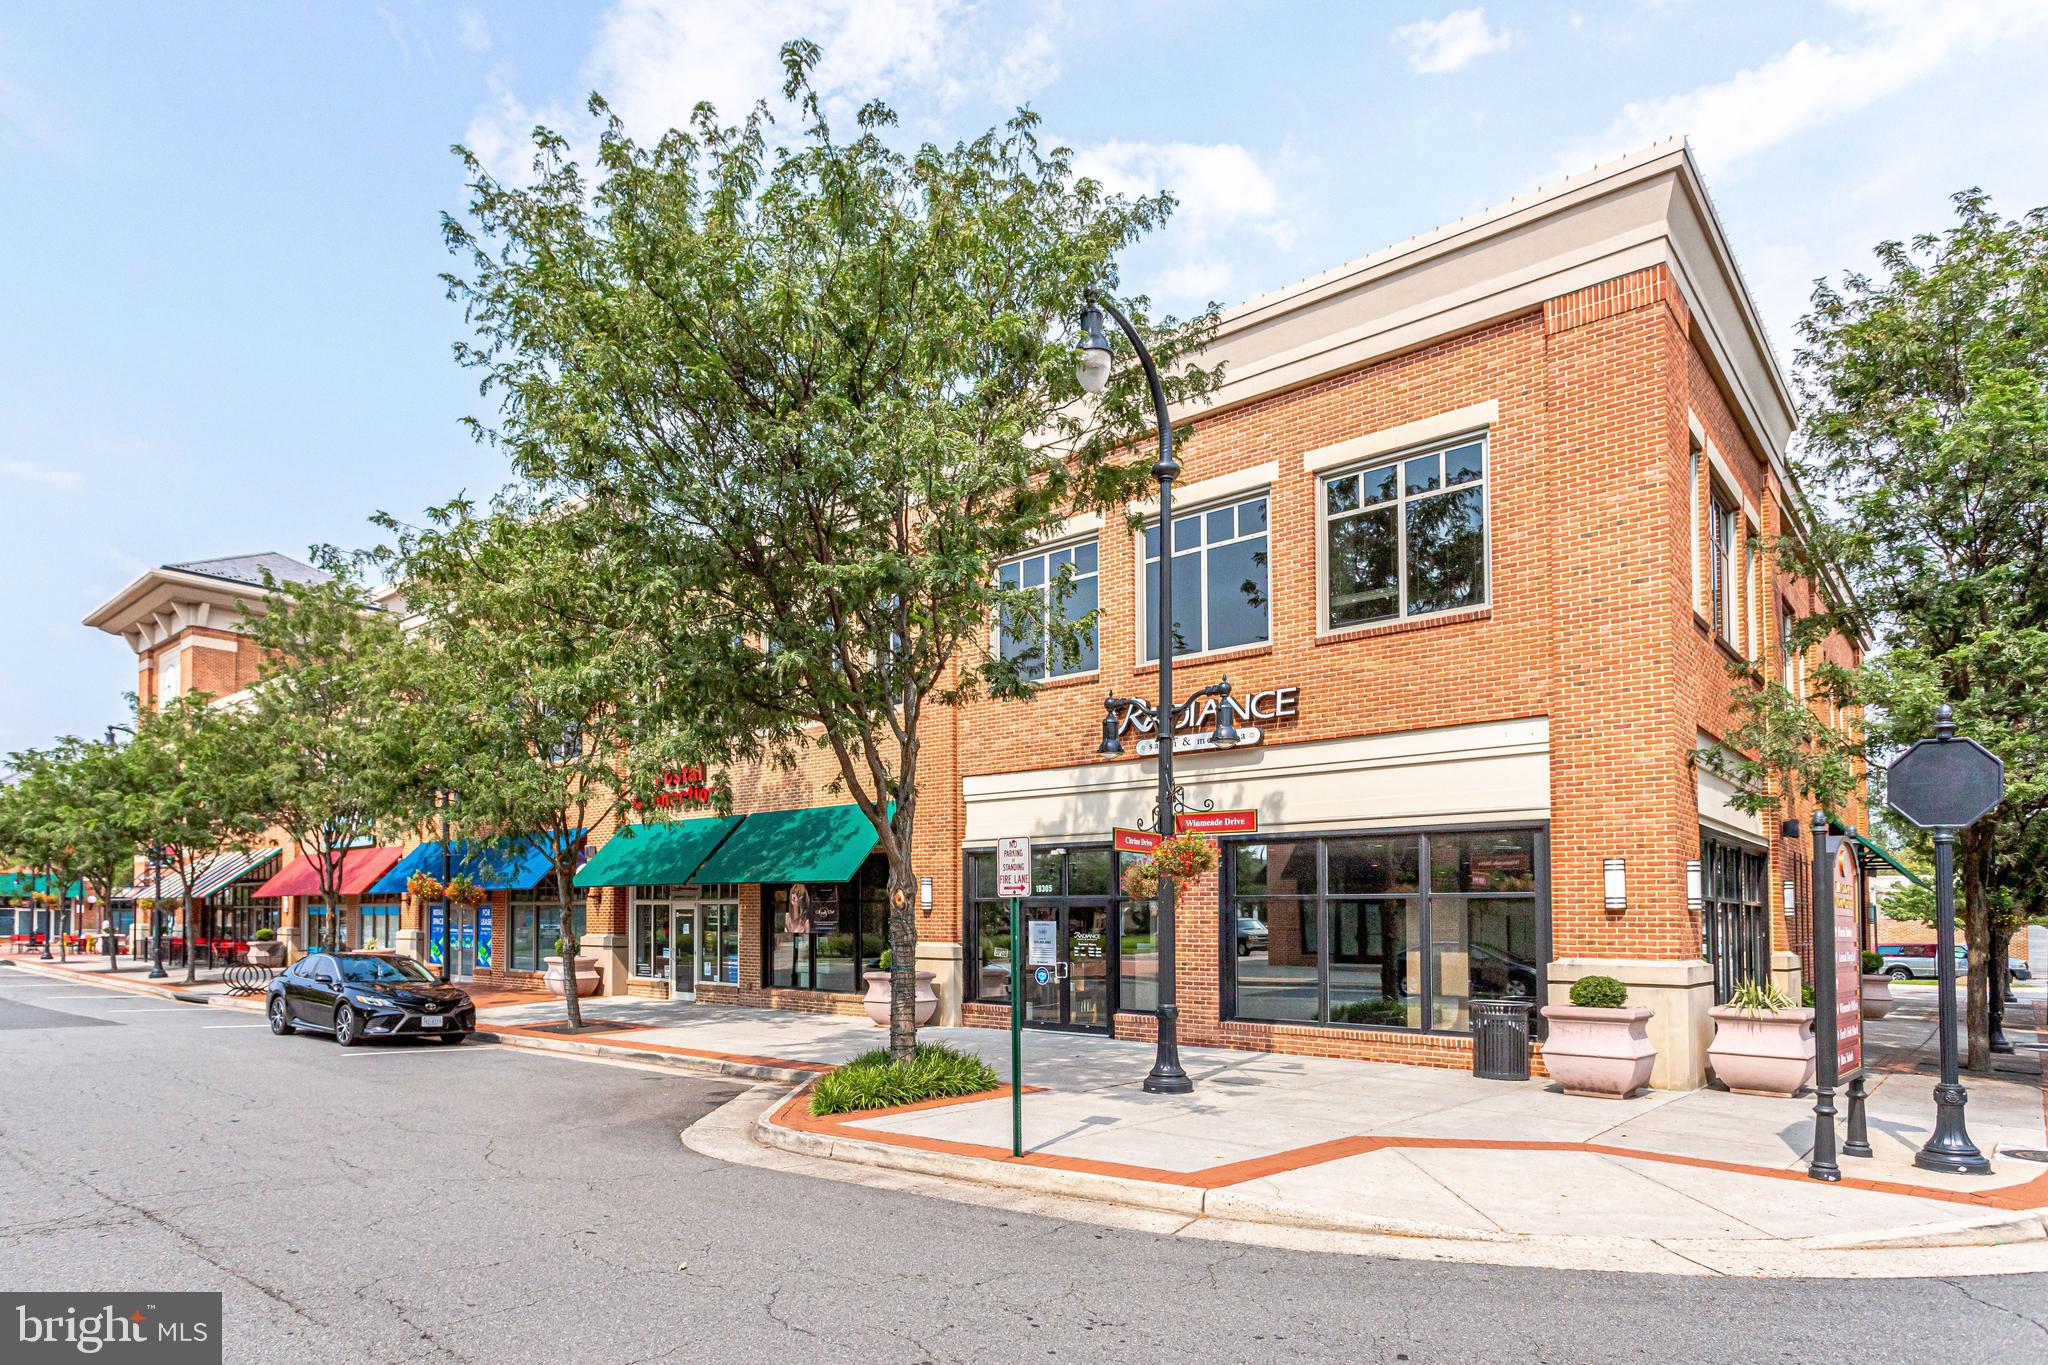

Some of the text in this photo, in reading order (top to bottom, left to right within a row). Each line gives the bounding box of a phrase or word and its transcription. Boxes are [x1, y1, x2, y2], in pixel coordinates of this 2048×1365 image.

[1182, 736, 1191, 746] &
[1185, 817, 1245, 827] Winmeade Drive
[1009, 840, 1018, 848] NO
[1140, 838, 1153, 847] Drive
[1003, 849, 1023, 858] PARKING
[1002, 863, 1025, 872] STANDING
[1000, 874, 1030, 885] FIRE LANE
